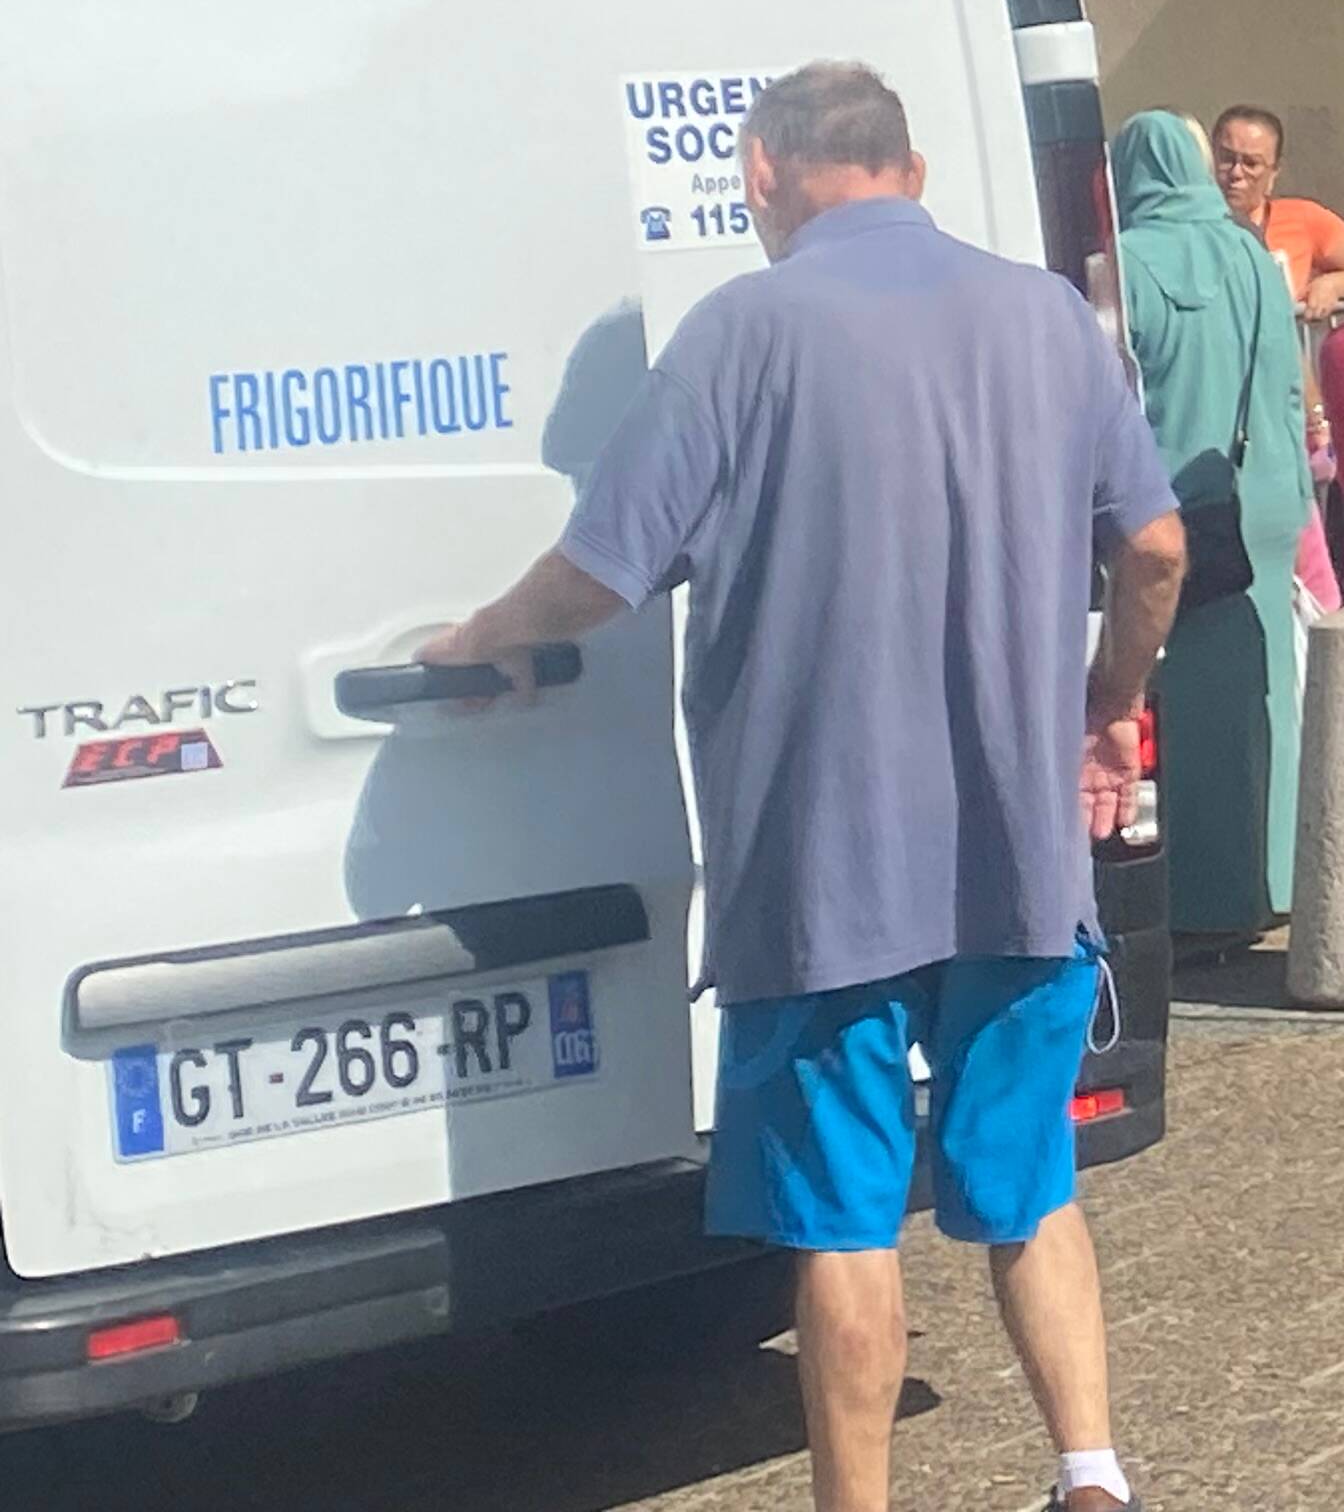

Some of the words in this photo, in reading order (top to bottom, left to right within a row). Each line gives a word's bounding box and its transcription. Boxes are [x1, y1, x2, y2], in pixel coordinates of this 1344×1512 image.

[646, 122, 736, 165] SOC
[691, 173, 742, 194] Appe
[690, 201, 750, 237] 115
[208, 353, 514, 455] FRIGORIFIQUE
[16, 679, 260, 739] TRAFIC
[132, 1109, 147, 1134] F
